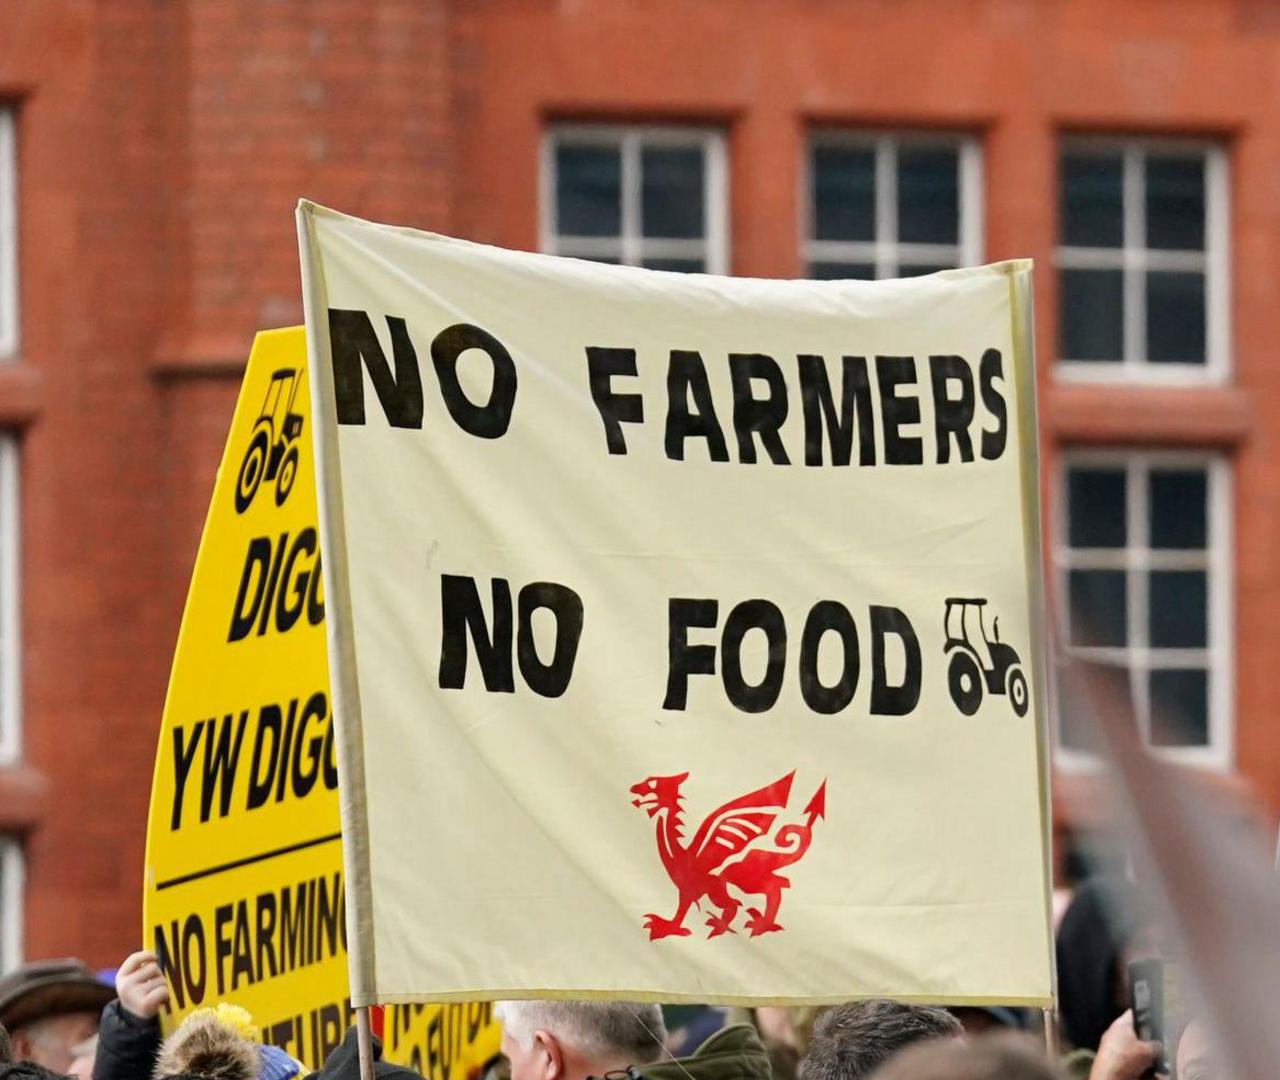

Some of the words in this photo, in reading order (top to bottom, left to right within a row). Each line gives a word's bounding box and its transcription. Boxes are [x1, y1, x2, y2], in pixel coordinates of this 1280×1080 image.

[328, 307, 518, 440] NO
[585, 346, 1008, 467] FARMERS
[438, 573, 584, 699] NO
[662, 597, 923, 716] FOOD
[171, 710, 249, 831] YW
[154, 913, 206, 1014] NO
[215, 872, 348, 996] FARMIN
